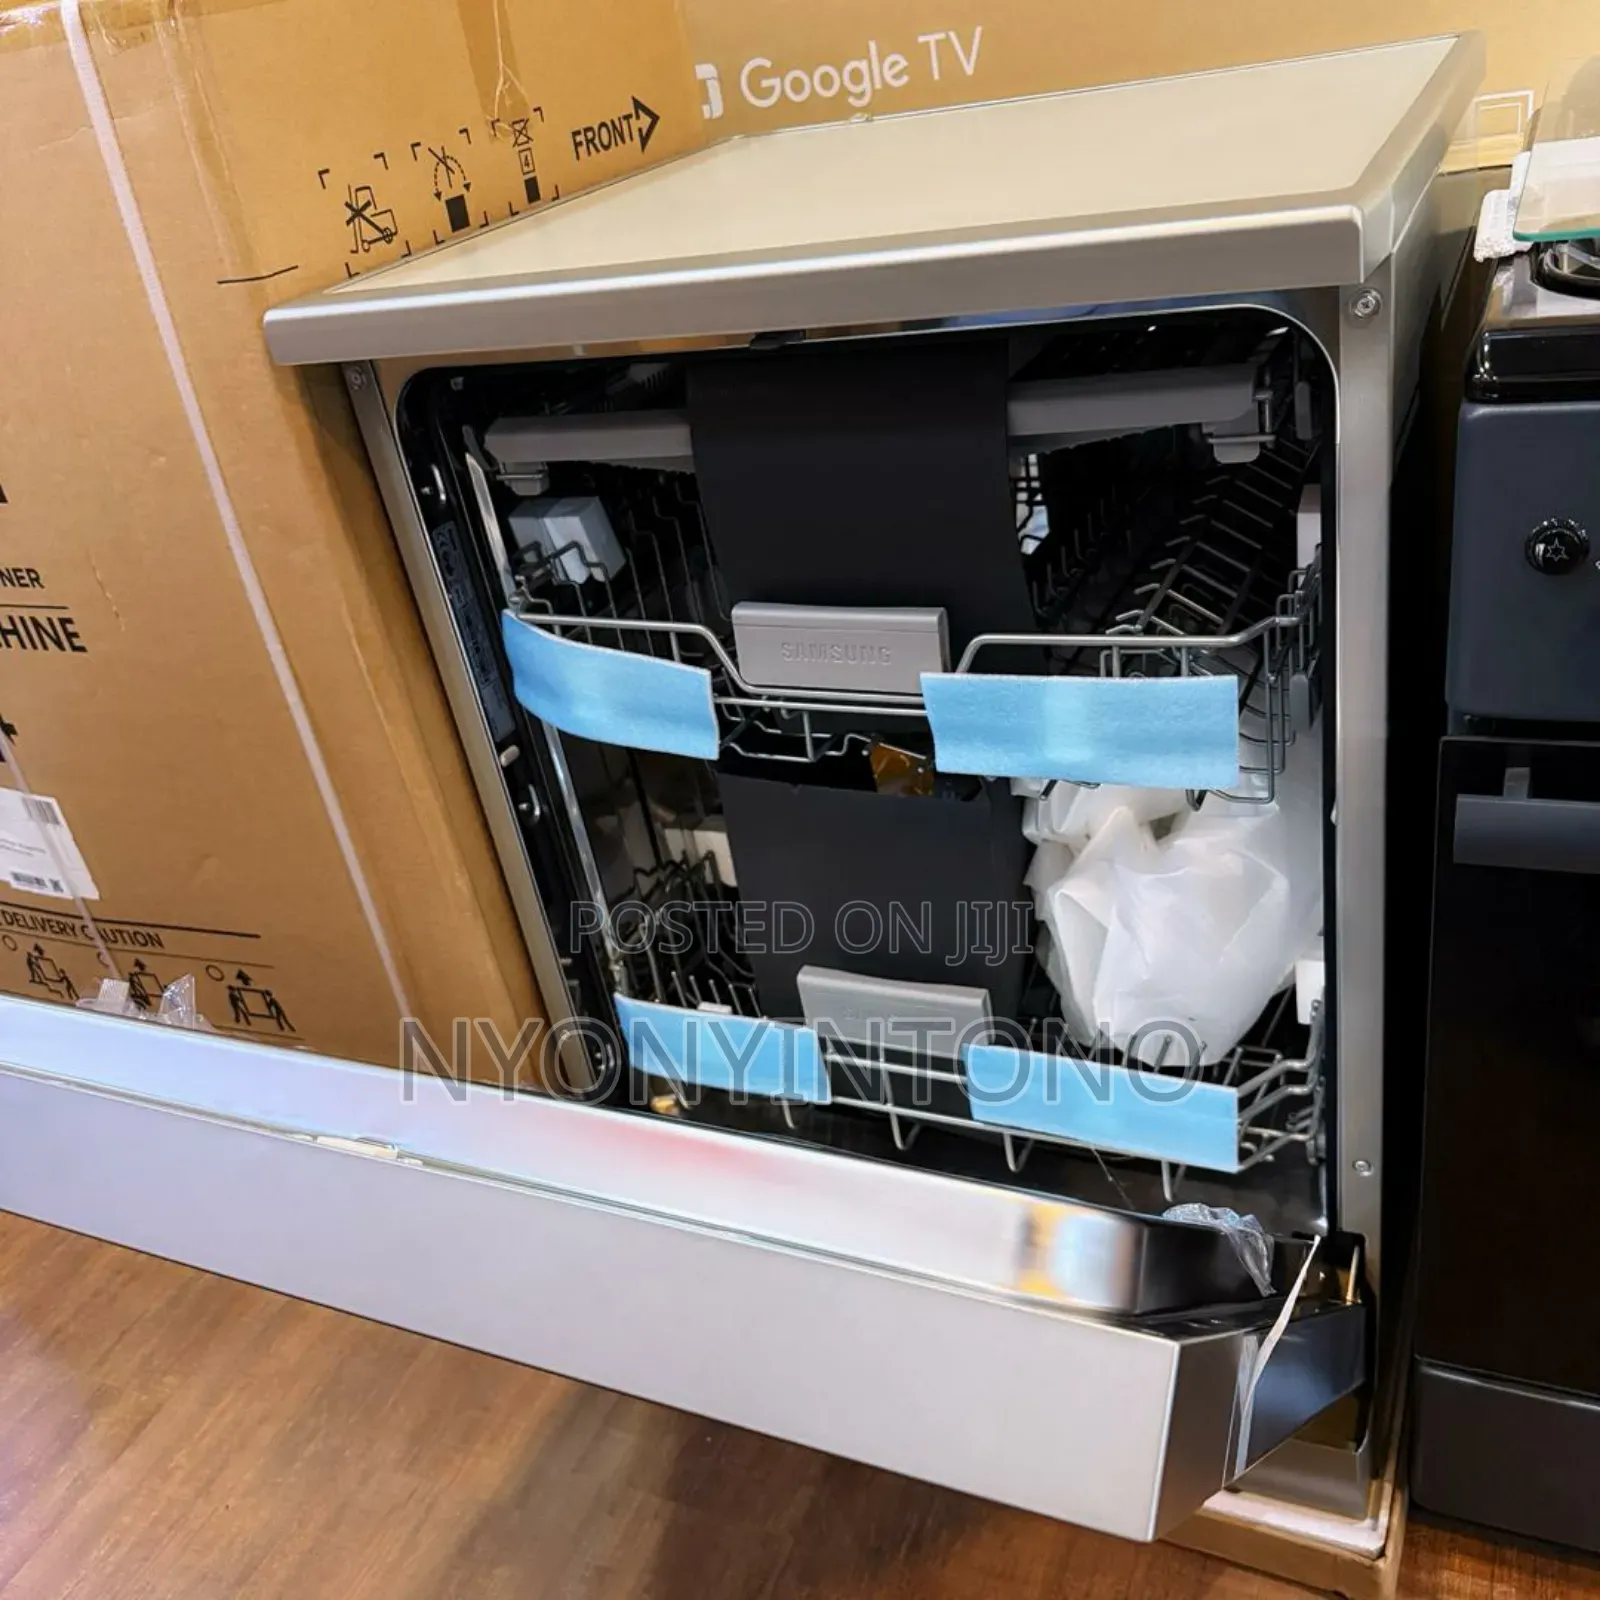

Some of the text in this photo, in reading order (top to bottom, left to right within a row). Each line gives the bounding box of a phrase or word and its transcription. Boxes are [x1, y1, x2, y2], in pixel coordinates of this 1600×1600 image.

[740, 25, 982, 108] Google TV
[571, 113, 633, 161] FRONT
[0, 614, 88, 652] HINE
[781, 642, 892, 665] SAMSUNG
[2, 910, 78, 938] DELIVERY
